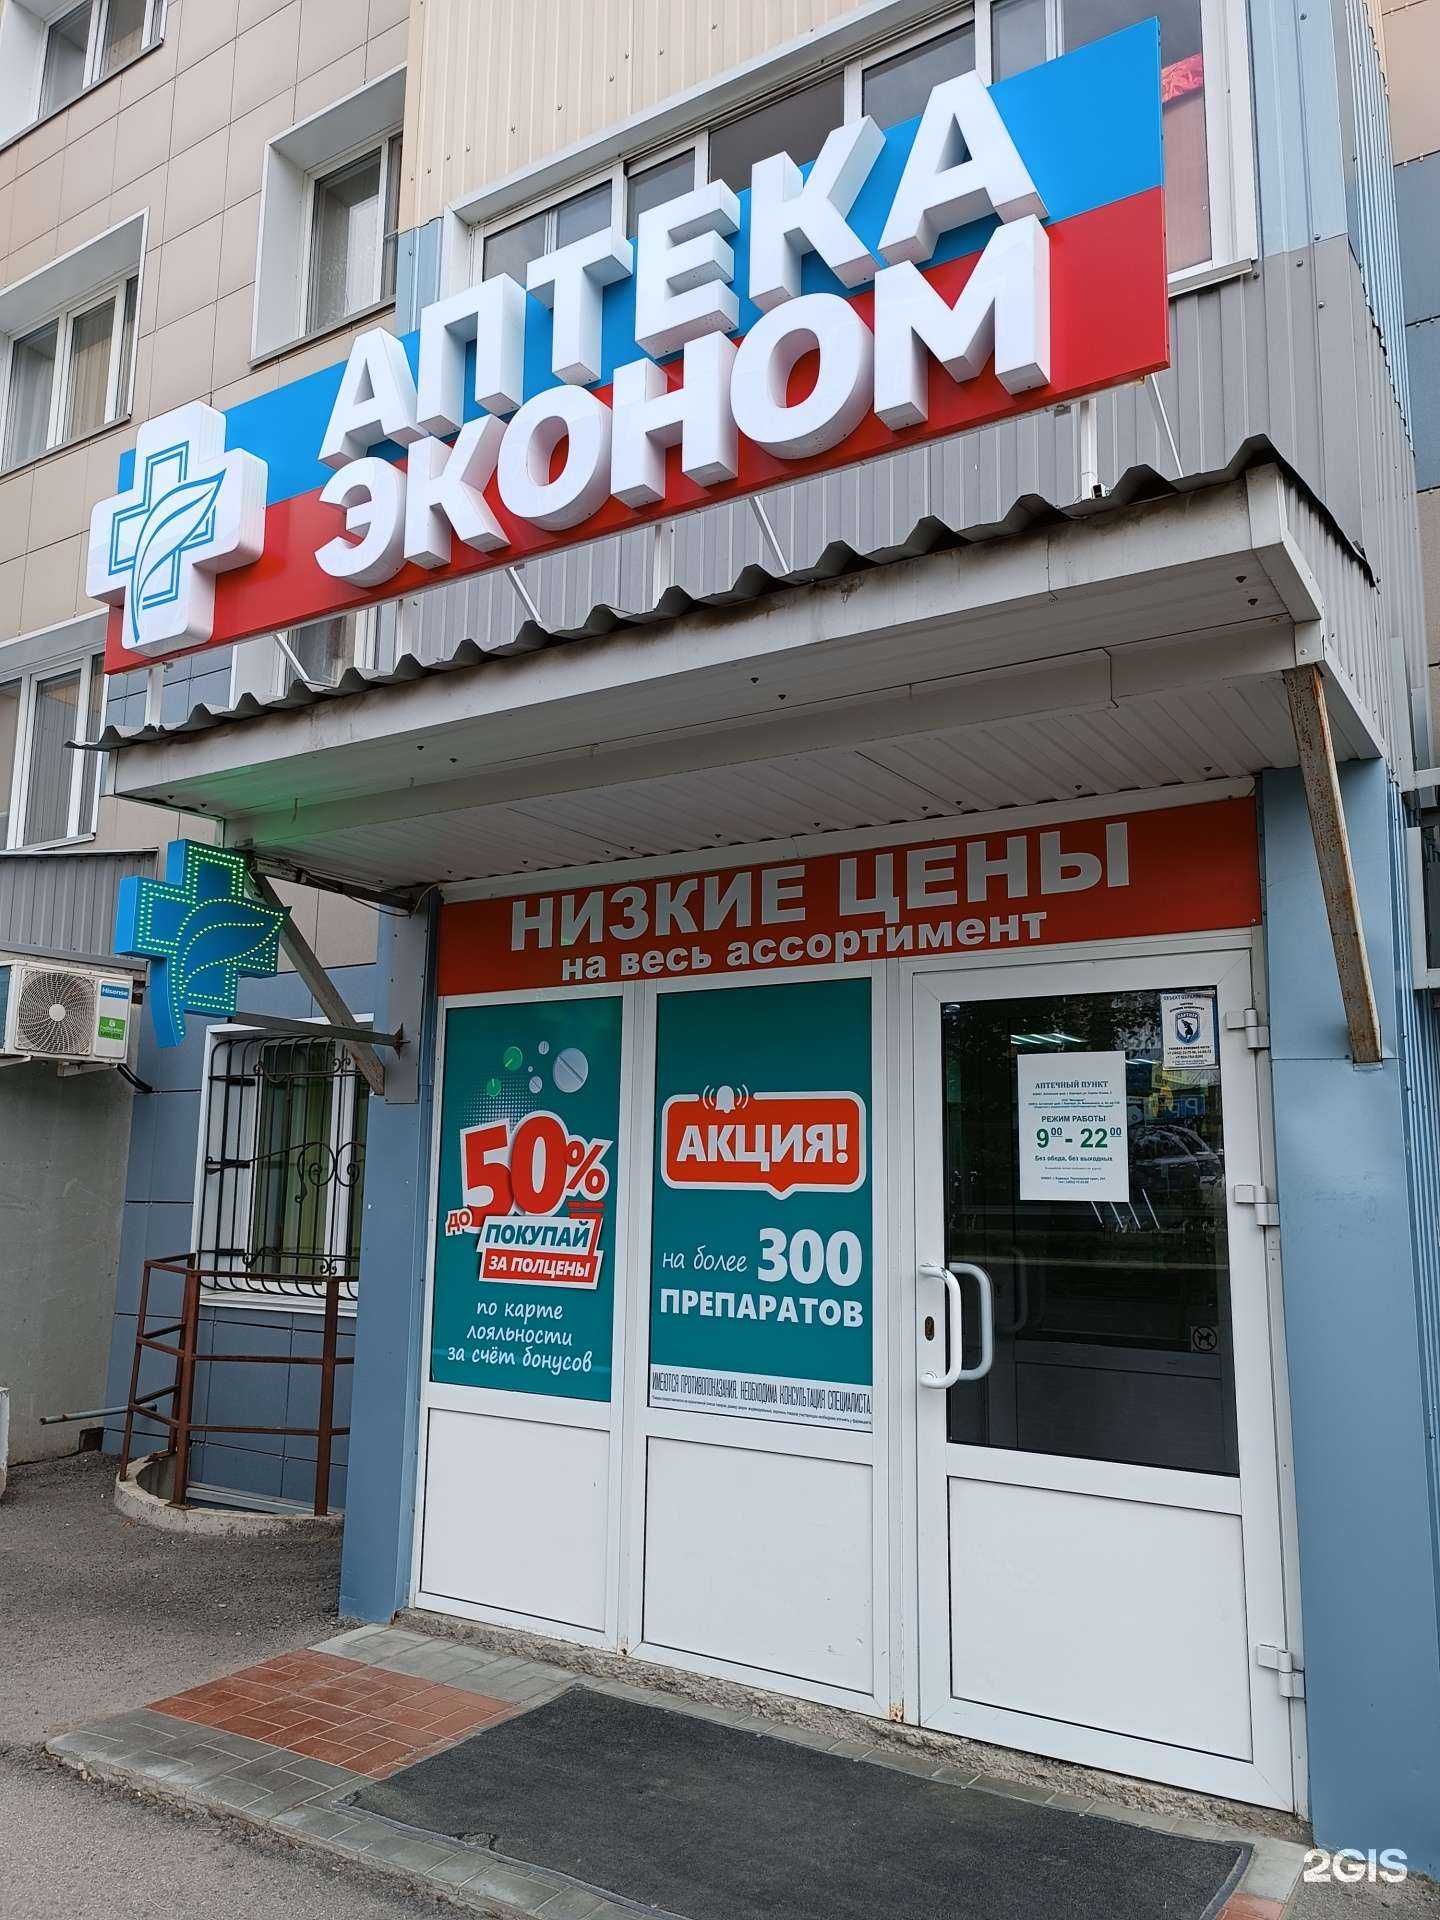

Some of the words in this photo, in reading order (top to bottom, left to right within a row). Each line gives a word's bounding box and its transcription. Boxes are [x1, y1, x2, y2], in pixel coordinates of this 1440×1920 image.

[318, 70, 1047, 468] АПТЕКА
[313, 215, 1051, 588] ЭКОНОМ
[511, 865, 806, 951] НИЗКИЕ
[839, 822, 1129, 924] ЦЕНЫ
[562, 955, 606, 981] на
[620, 946, 712, 976] весь
[727, 911, 1047, 966] ассортимент
[102, 986, 128, 996] Hisense
[1035, 1080, 1079, 1089] АПТЕЧНЫЙ
[1081, 1080, 1109, 1088] ПУНКТ
[1041, 1115, 1070, 1123] РЕЖИМ
[1072, 1115, 1106, 1123] РАБОТЫ
[675, 1123, 849, 1173] АКЦИЯ!
[463, 1113, 609, 1229] 50%
[484, 1220, 591, 1248] ПОКУПАЙ
[488, 1256, 507, 1271] ЗА
[511, 1257, 591, 1279] ПОЛЦЕНЫ
[662, 1250, 685, 1270] на
[693, 1245, 748, 1273] более
[757, 1227, 863, 1287] 300
[476, 1302, 498, 1316] по
[504, 1302, 564, 1324] карте
[660, 1288, 864, 1328] ПРЕПАРАТОВ
[466, 1324, 573, 1346] лояльности
[447, 1346, 465, 1361] за
[471, 1346, 516, 1366] счёт
[522, 1349, 593, 1375] бонусов
[652, 1371, 679, 1392] ИМЕЮТСЯ
